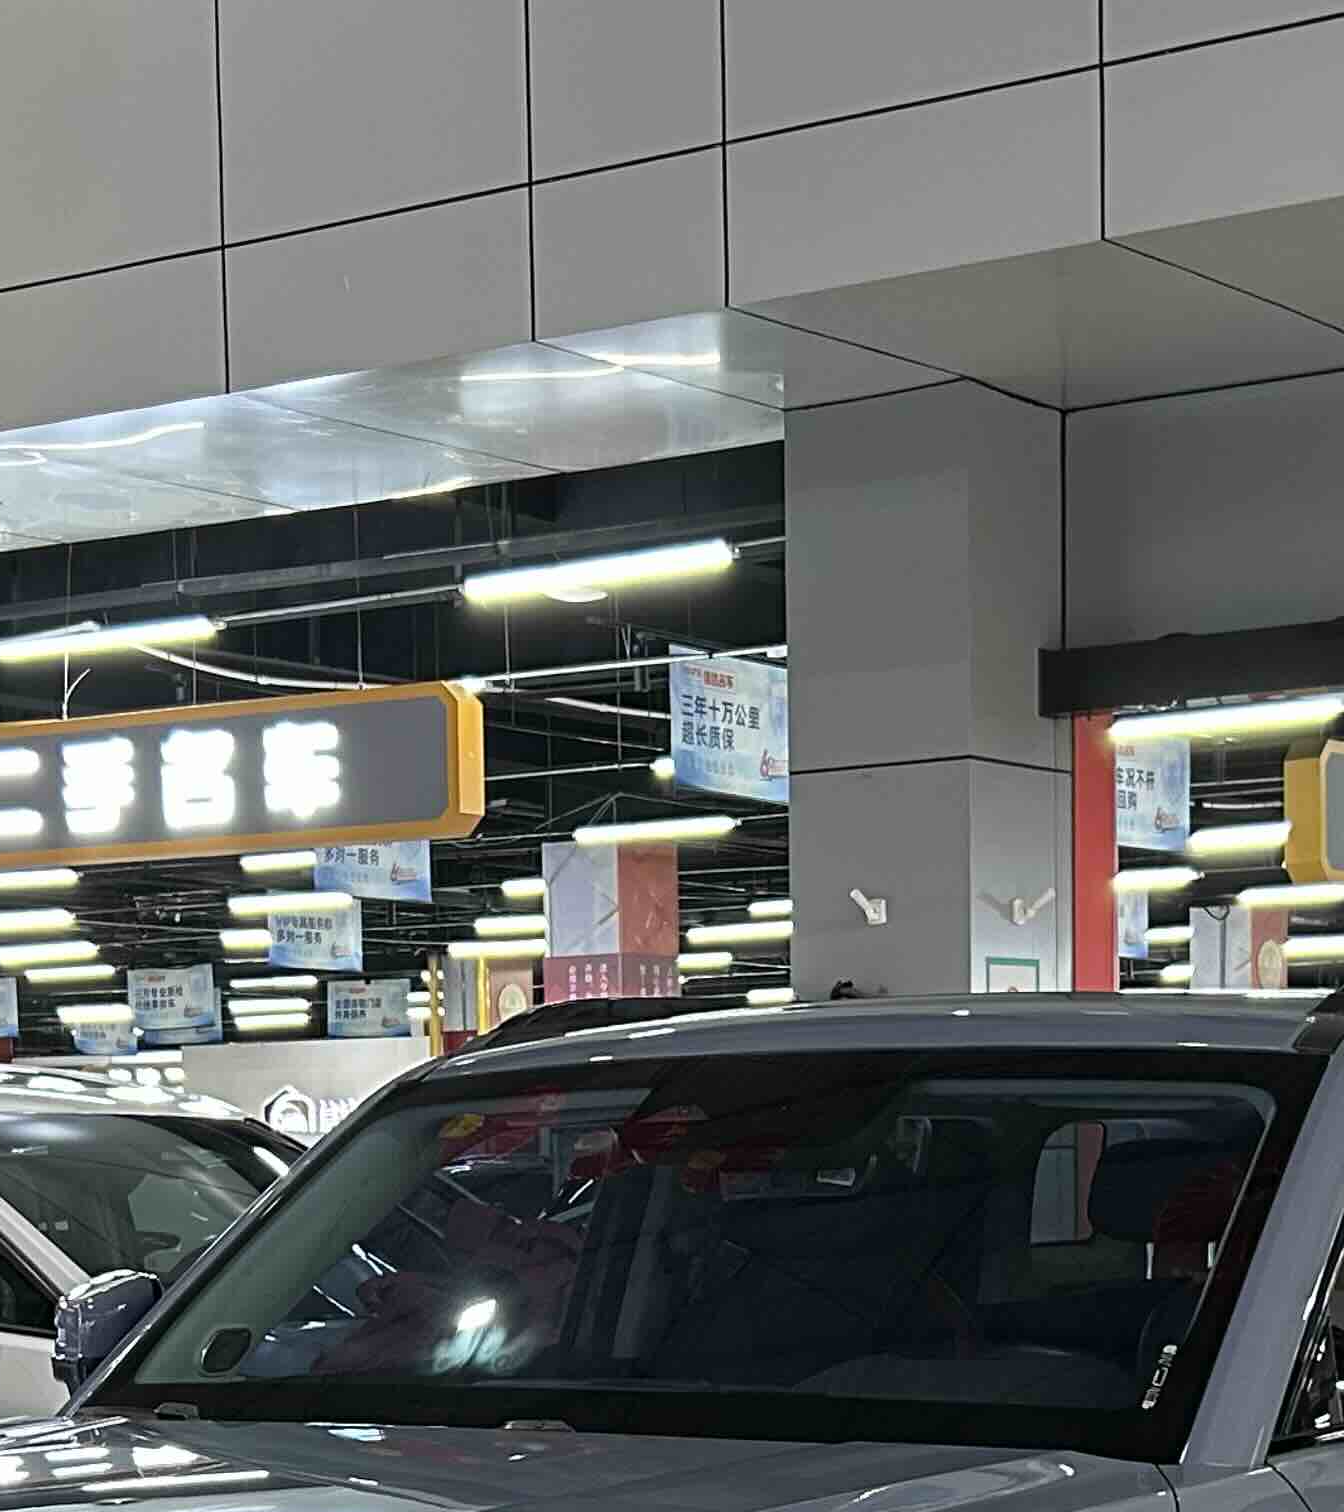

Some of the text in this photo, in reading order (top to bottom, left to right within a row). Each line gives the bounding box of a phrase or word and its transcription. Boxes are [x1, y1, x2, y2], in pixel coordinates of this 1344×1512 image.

[680, 693, 761, 730] 三年十万公里
[680, 720, 735, 750] 超长质保
